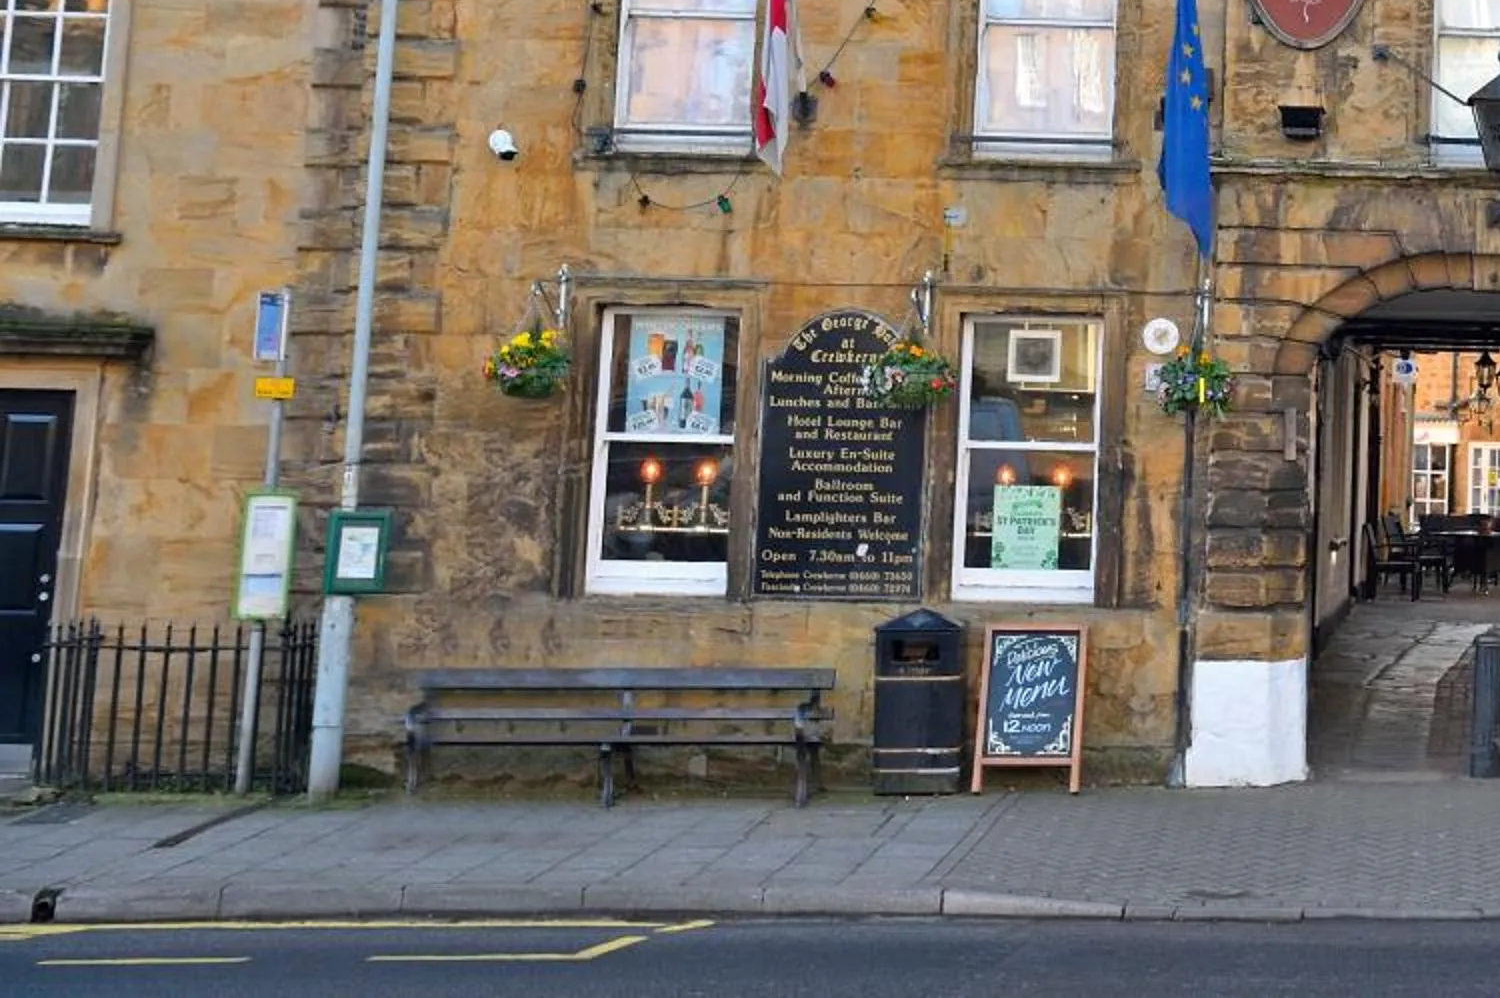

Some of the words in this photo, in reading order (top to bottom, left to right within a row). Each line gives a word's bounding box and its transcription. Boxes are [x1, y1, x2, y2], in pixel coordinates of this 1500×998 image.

[792, 329, 818, 351] The
[821, 316, 870, 332] George
[841, 338, 855, 350] at
[771, 370, 823, 385] Morning
[829, 371, 867, 384] Coffe
[770, 396, 821, 408] Lunches
[827, 397, 849, 409] and
[856, 398, 878, 409] Bar
[787, 414, 821, 427] Hotel
[828, 415, 875, 430] Lounge
[880, 417, 903, 428] Bar
[796, 429, 819, 440] and
[824, 429, 894, 441] Restaurant
[789, 446, 835, 461] Luxury
[840, 447, 896, 461] En-Suite
[791, 460, 894, 473] Accommodation
[815, 478, 875, 491] Ballroom
[778, 491, 801, 502] and
[808, 490, 864, 503] Function
[870, 492, 904, 504] Suite
[785, 509, 867, 525] Lamplighters
[873, 512, 897, 524] Bar
[768, 526, 852, 540] Non-Residents
[857, 529, 909, 542] Welcome
[761, 549, 797, 563] Open
[808, 549, 855, 563] 7.30am
[881, 551, 913, 565] 11pm
[1003, 720, 1020, 733] 12
